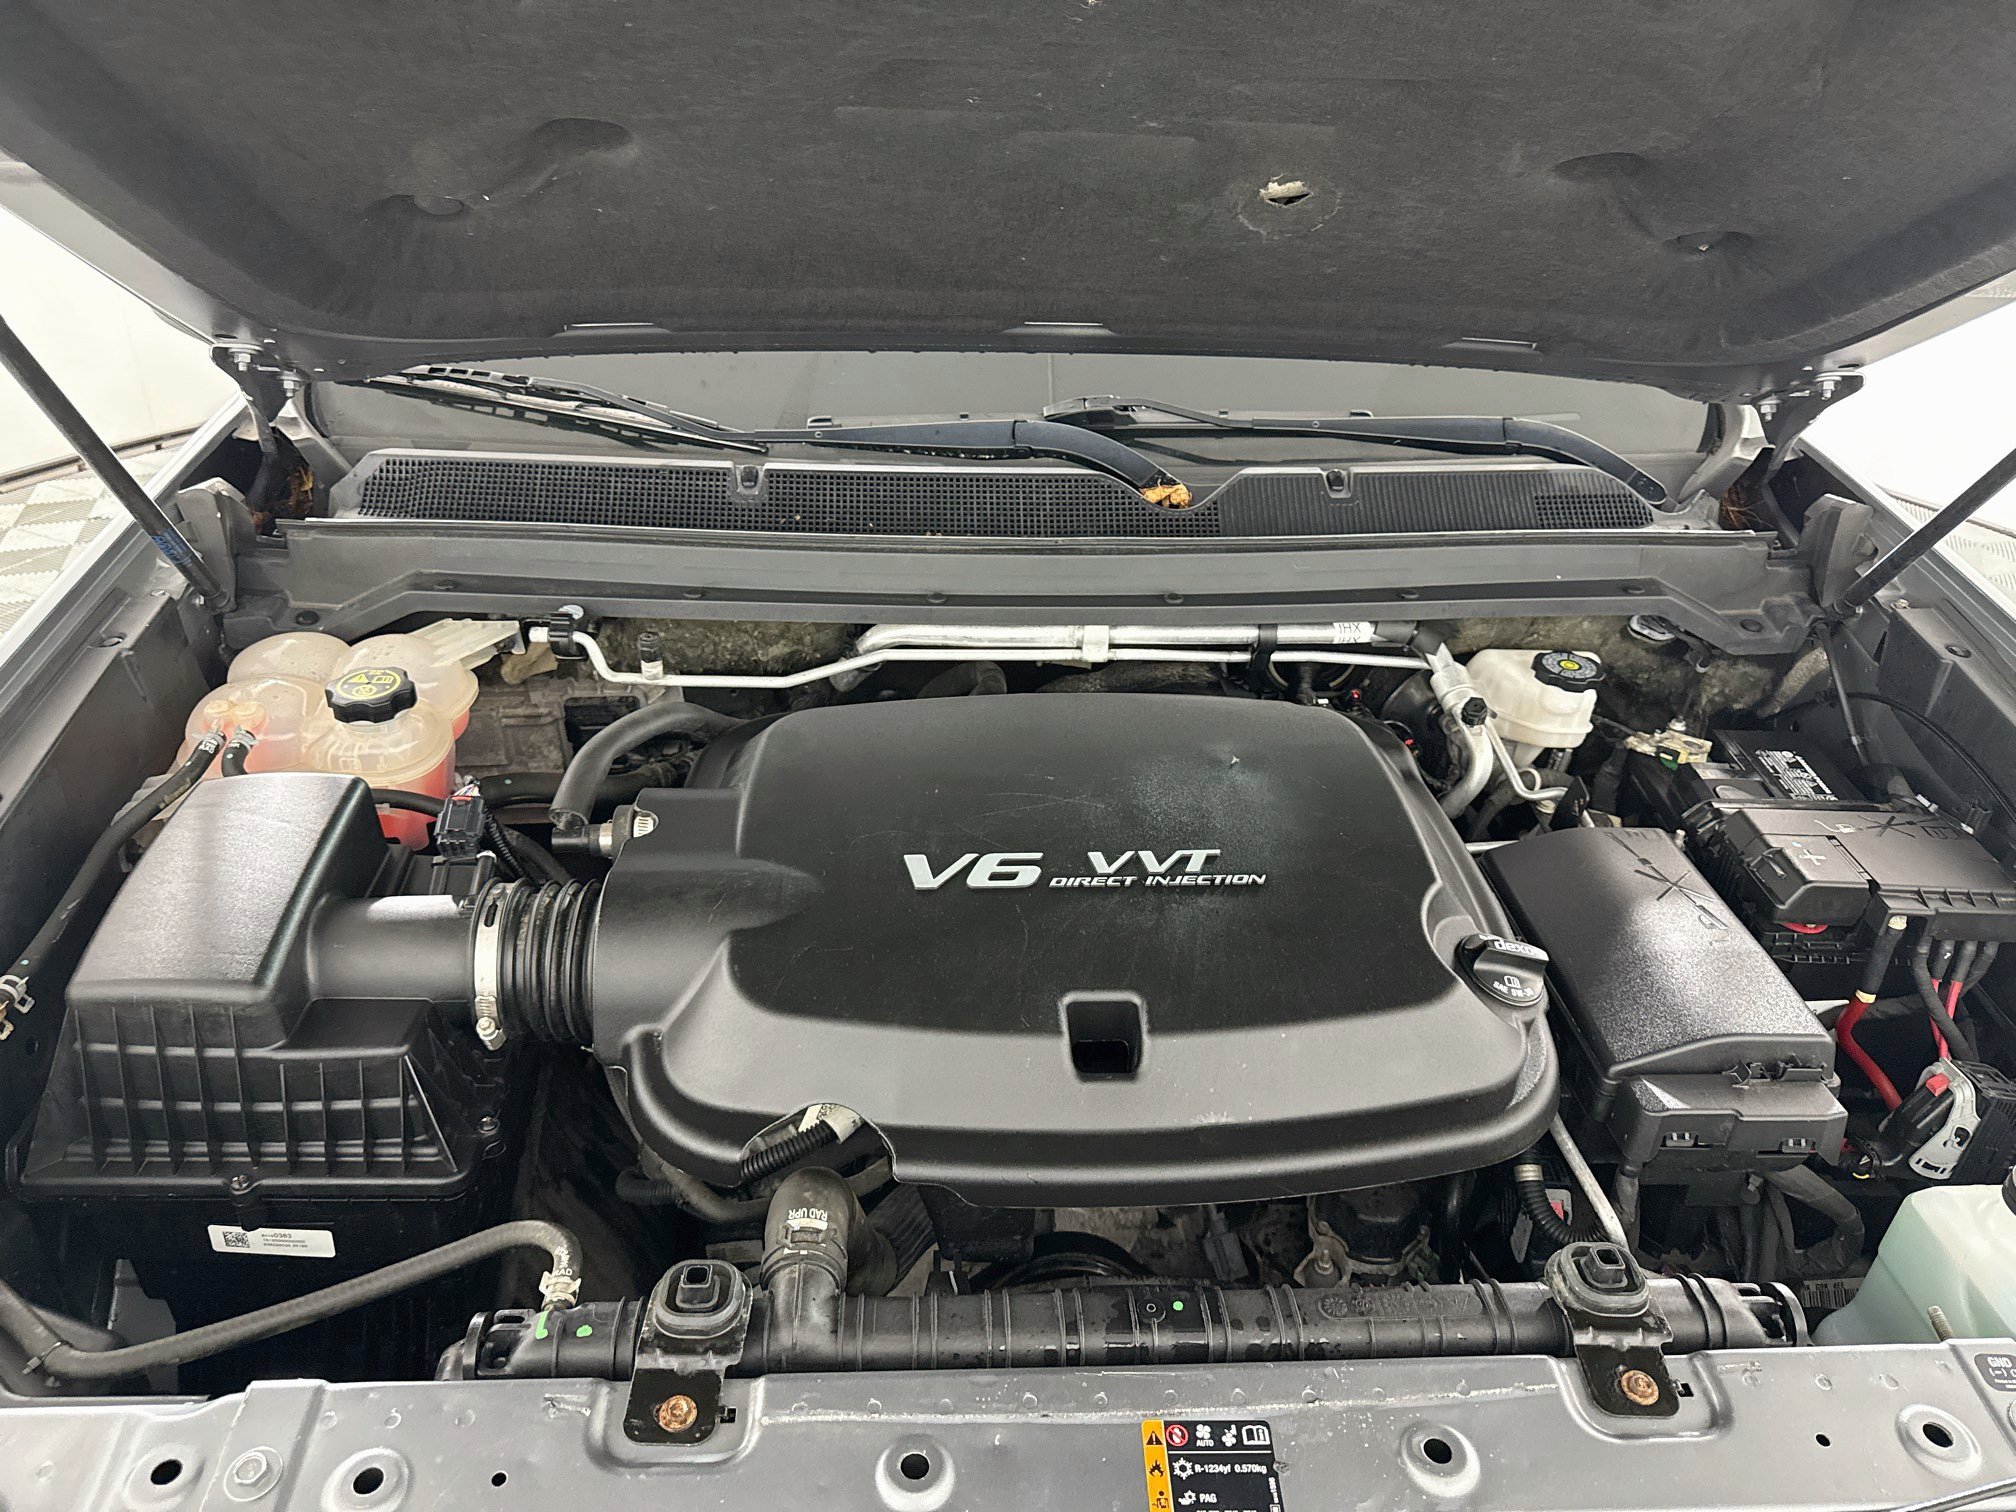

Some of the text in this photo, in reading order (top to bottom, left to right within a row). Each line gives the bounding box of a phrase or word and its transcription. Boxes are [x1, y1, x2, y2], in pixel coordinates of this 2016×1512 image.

[903, 849, 1221, 890] V6 VVT
[1049, 874, 1267, 888] DIRECT INJECTION
[1492, 980, 1509, 994] SAE
[788, 1207, 828, 1222] RAD UPR
[1987, 1356, 2012, 1368] GND
[1196, 1439, 1215, 1447] AUTO
[1194, 1463, 1267, 1475] R-1234yf 0.570kg
[1199, 1493, 1218, 1503] PAG
